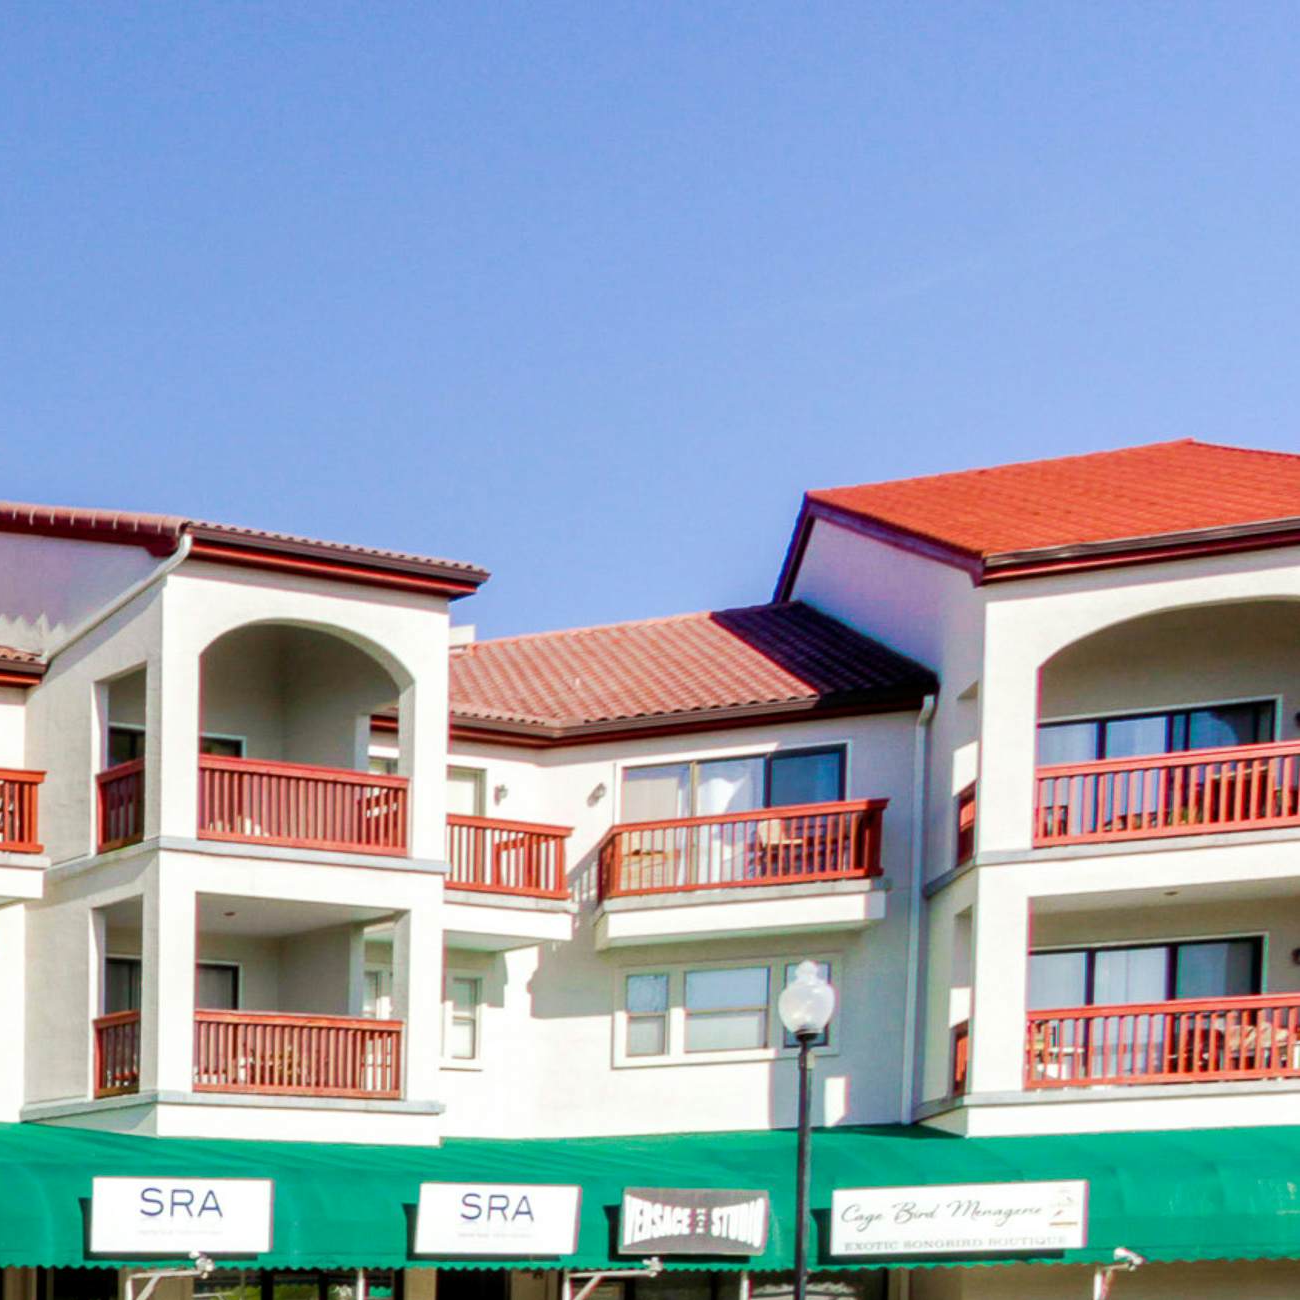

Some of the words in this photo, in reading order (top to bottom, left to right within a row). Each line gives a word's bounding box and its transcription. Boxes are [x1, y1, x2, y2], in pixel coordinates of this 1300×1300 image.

[140, 1187, 224, 1218] SRA
[460, 1192, 535, 1222] SRA
[841, 1204, 883, 1233] Cage
[892, 1201, 940, 1224] Bird
[623, 1193, 691, 1246] VERSACE
[711, 1197, 766, 1248] STUDIO
[844, 1240, 899, 1252] EXOTIC
